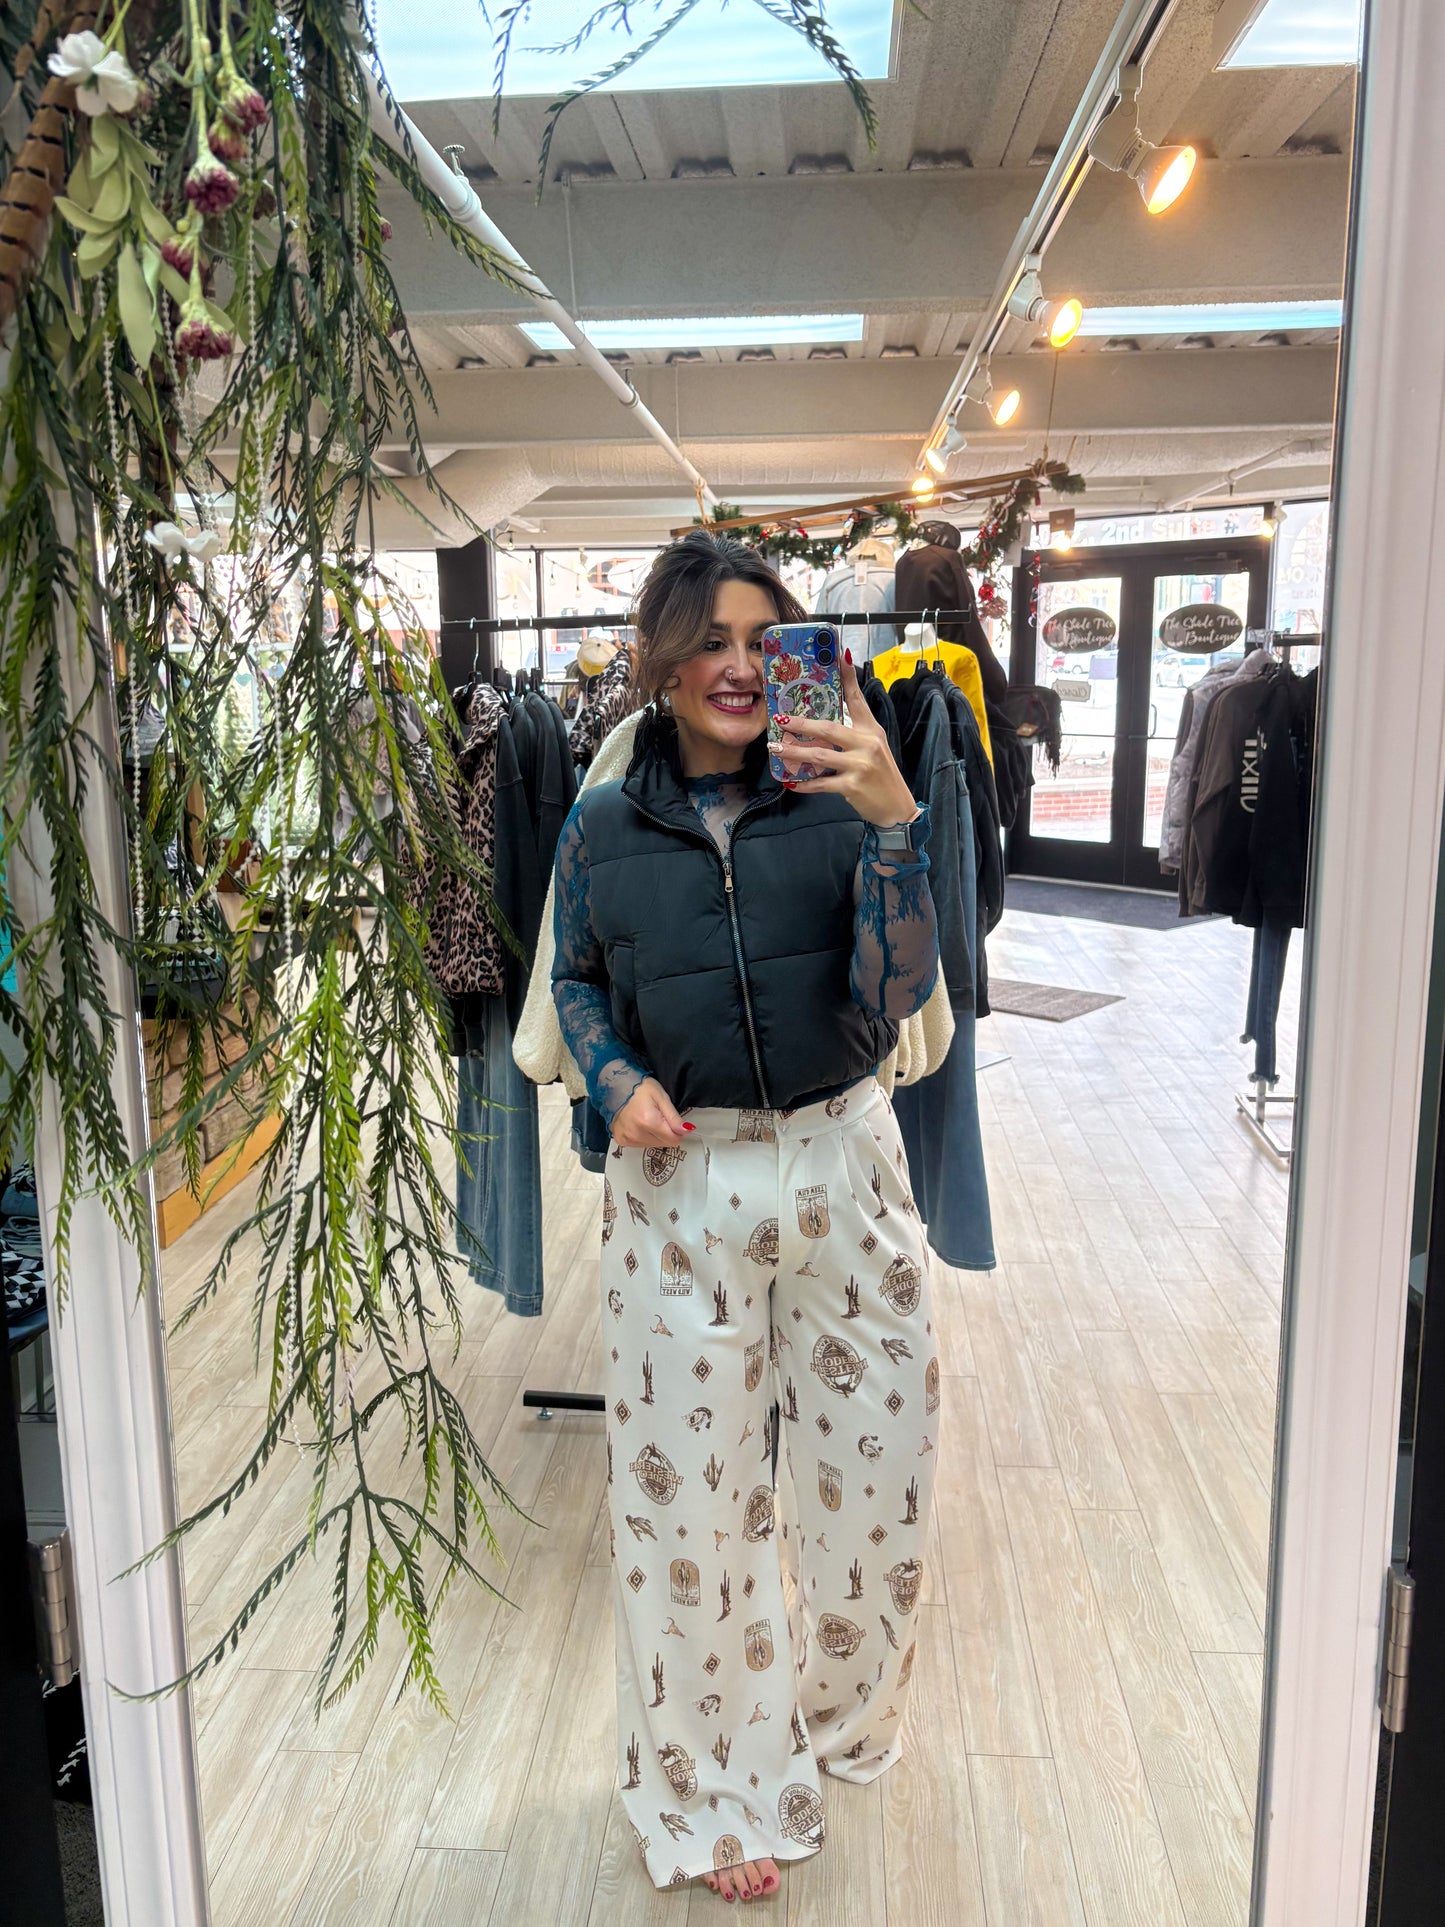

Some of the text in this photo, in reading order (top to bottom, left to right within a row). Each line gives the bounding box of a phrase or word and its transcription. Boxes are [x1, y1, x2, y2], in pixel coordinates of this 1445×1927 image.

[1102, 520, 1145, 543] 2nd
[1164, 614, 1241, 632] The Shade Tree
[1185, 630, 1240, 648] Boutique
